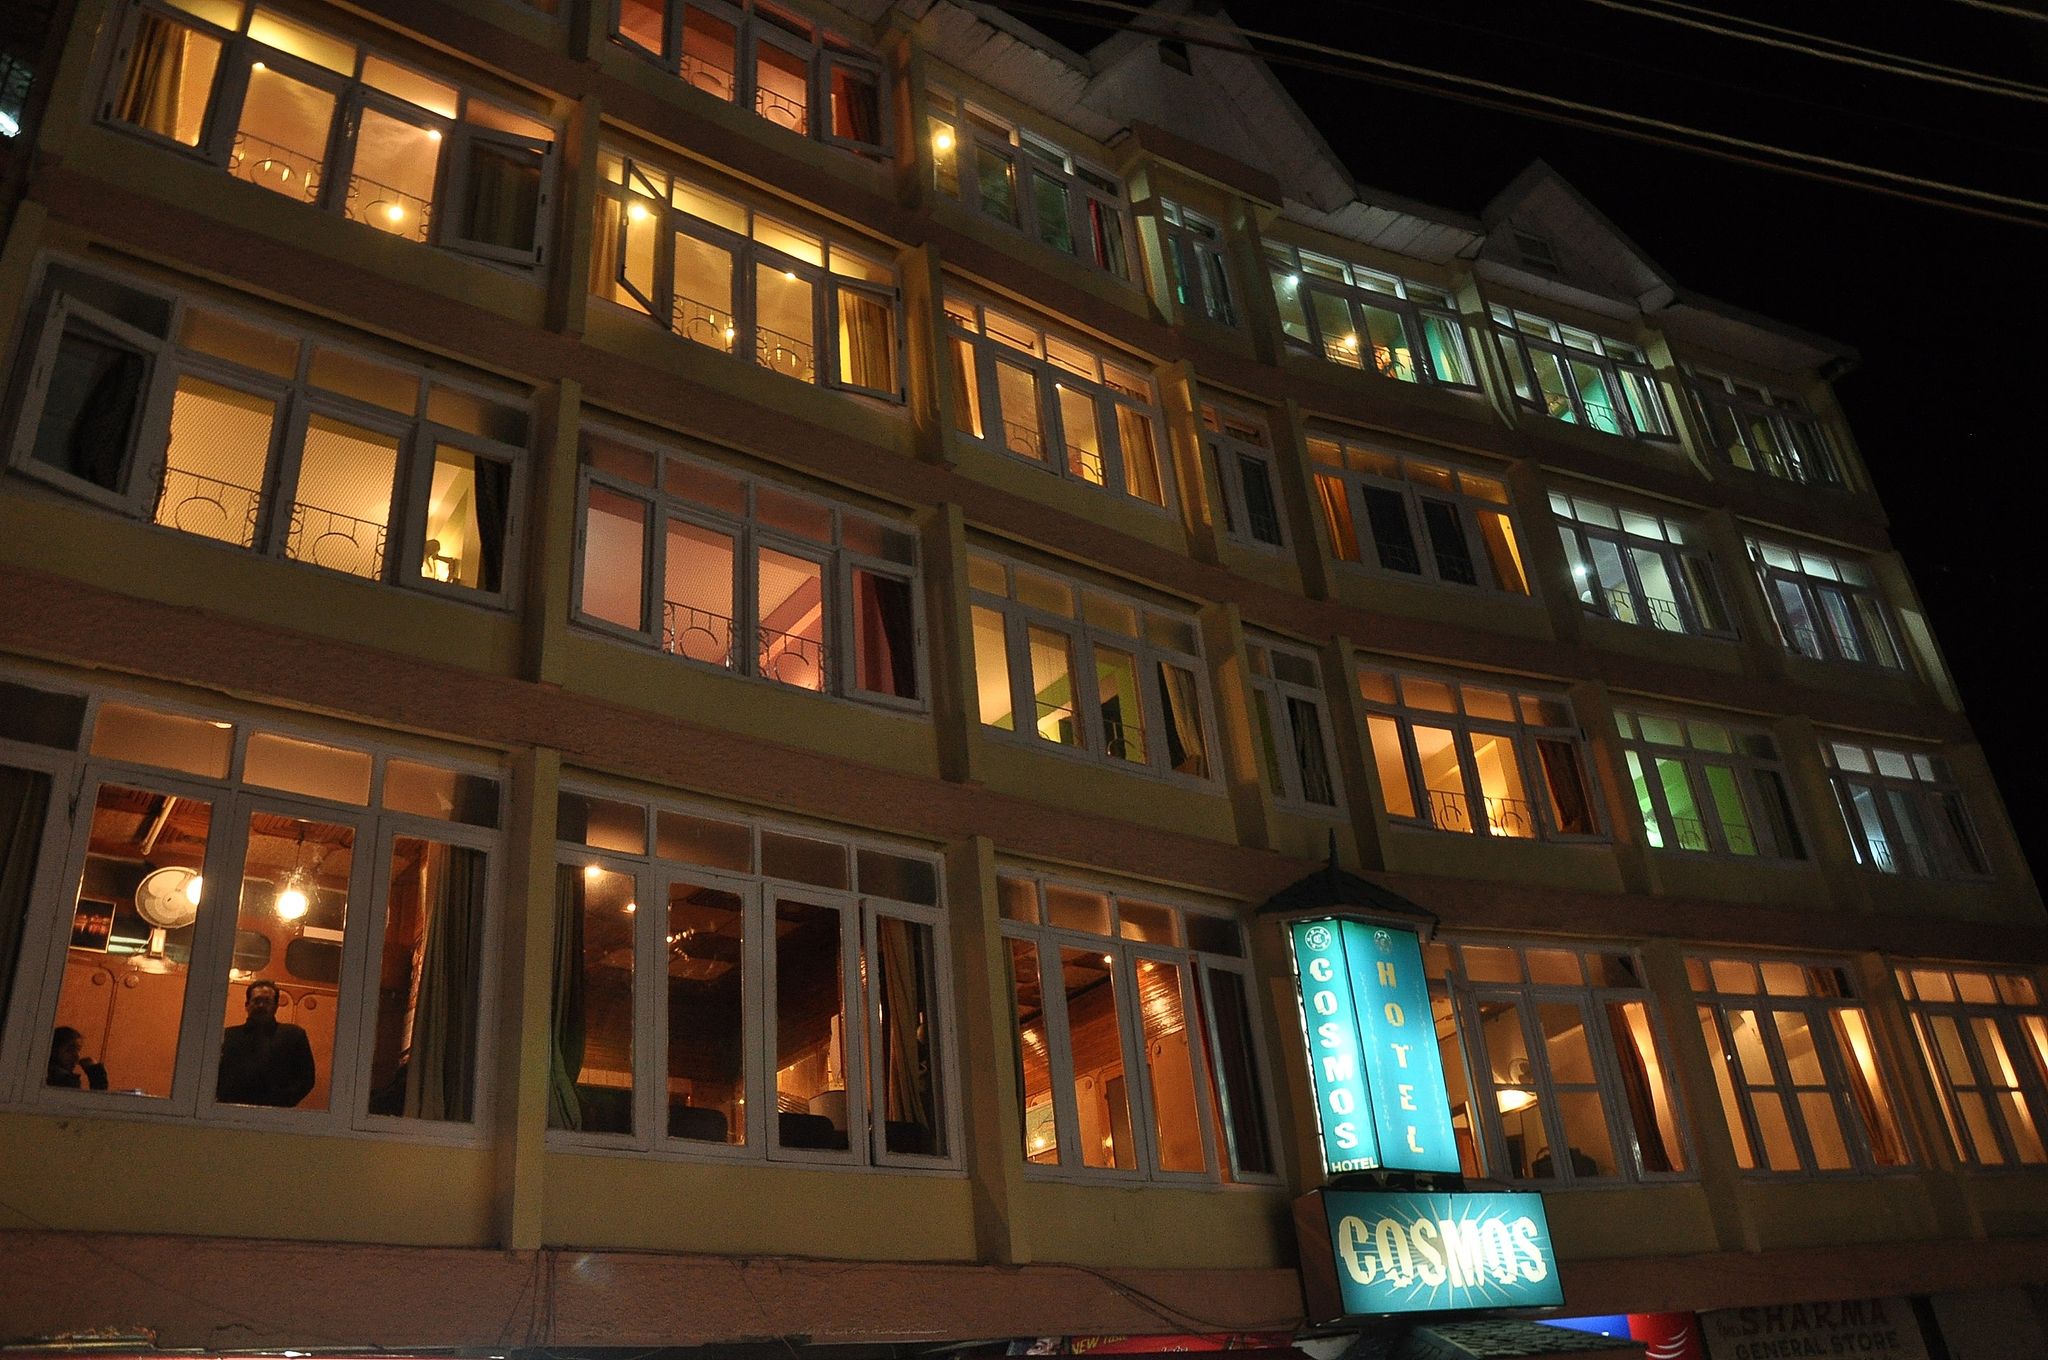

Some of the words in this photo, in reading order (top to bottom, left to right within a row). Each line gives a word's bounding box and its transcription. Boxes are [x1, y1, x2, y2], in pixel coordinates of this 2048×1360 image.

[1308, 957, 1359, 1150] COSMOS
[1376, 960, 1425, 1154] HOTEL
[1331, 1156, 1379, 1173] HOTEL
[1338, 1215, 1548, 1288] COSMOS
[1738, 1297, 1889, 1336] SHARMA
[1071, 1336, 1100, 1355] NEW
[1735, 1336, 1828, 1360] GENERAL
[1831, 1330, 1898, 1354] STORE
